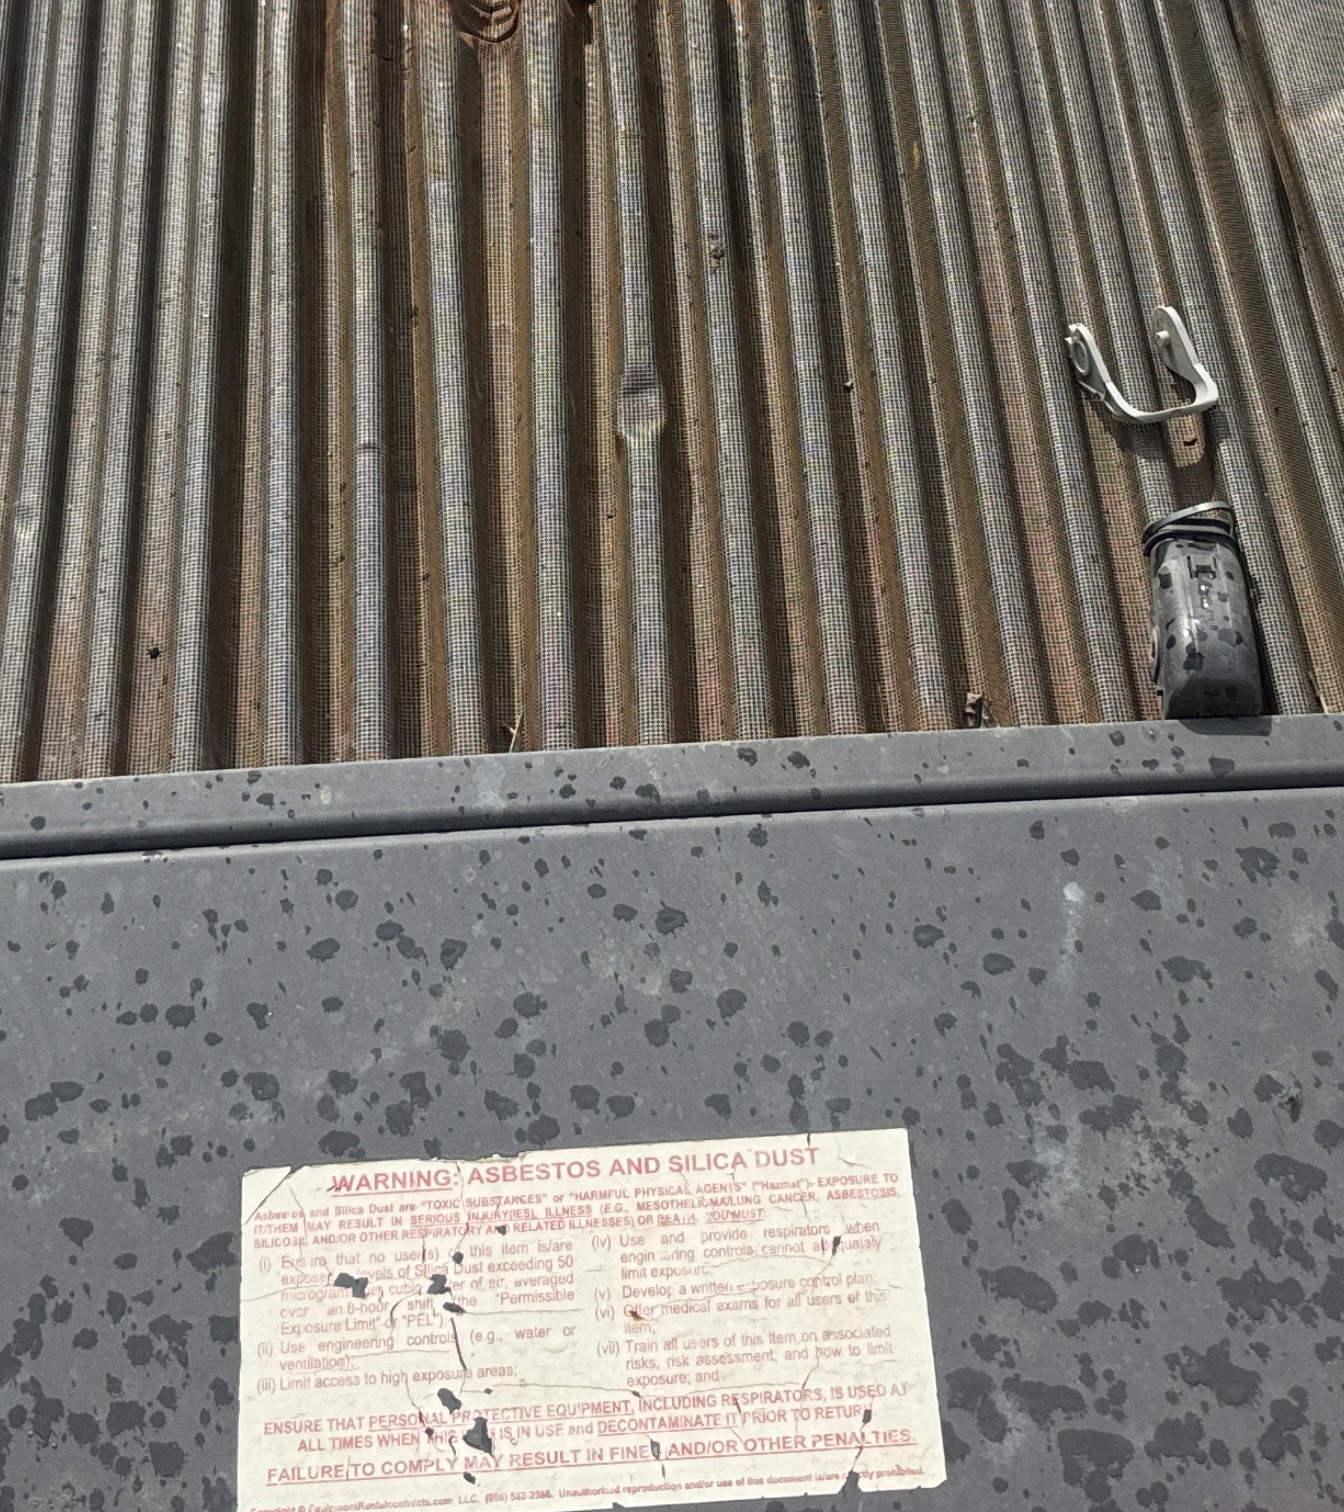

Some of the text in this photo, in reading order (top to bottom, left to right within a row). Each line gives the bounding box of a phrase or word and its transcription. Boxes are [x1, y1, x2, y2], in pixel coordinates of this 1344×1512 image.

[330, 1147, 820, 1193] WARNING: ASBESTOS AND SILICA DUST
[309, 1206, 330, 1218] and
[368, 1203, 395, 1215] Dust
[552, 1193, 564, 1203] or
[634, 1184, 691, 1198] PHYSICAL
[817, 1172, 879, 1188] EXPOSURE
[883, 1171, 899, 1184] TO
[306, 1220, 332, 1233] MAY
[338, 1216, 384, 1230] RESULT
[390, 1214, 403, 1226] IN
[410, 1211, 461, 1225] SERIOUS
[544, 1204, 593, 1218] ILLNESS
[359, 1230, 399, 1243] OTHER
[401, 1226, 482, 1240] RESPIRATORY
[512, 1219, 566, 1233] RELATED
[636, 1215, 654, 1226] OR
[619, 1233, 645, 1248] Use
[660, 1230, 685, 1245] and
[701, 1226, 748, 1246] provide
[763, 1223, 831, 1241] respirators
[335, 1251, 360, 1266] that
[368, 1251, 386, 1264] no
[469, 1240, 492, 1257] this
[501, 1239, 529, 1256] item
[703, 1243, 754, 1259] controls
[397, 1263, 412, 1279] of
[487, 1256, 554, 1275] exceeding
[557, 1254, 574, 1269] 50
[620, 1265, 648, 1281] limit
[470, 1275, 484, 1289] of
[513, 1273, 574, 1290] averaged
[678, 1284, 688, 1296] a
[407, 1297, 435, 1312] shift
[660, 1298, 712, 1316] medical
[715, 1297, 760, 1313] exams
[764, 1295, 782, 1310] for
[786, 1293, 802, 1308] all
[806, 1292, 843, 1307] users
[846, 1290, 861, 1305] of
[864, 1288, 888, 1304] this
[280, 1340, 306, 1355] Use
[317, 1336, 394, 1355] engineering
[406, 1331, 457, 1347] controls
[514, 1325, 552, 1340] water
[562, 1325, 577, 1337] or
[624, 1338, 659, 1355] Train
[662, 1337, 679, 1352] all
[683, 1334, 720, 1351] users
[723, 1333, 737, 1348] of
[741, 1331, 765, 1347] this
[768, 1329, 796, 1346] item
[800, 1329, 818, 1343] on
[625, 1340, 895, 1372] risks, risk assessment, and how to limit
[279, 1376, 311, 1392] Limit
[314, 1374, 361, 1389] access
[364, 1372, 377, 1386] to
[380, 1369, 408, 1387] high
[694, 1368, 721, 1384] and
[263, 1417, 323, 1436] ENSURE
[327, 1415, 366, 1432] THAT
[368, 1411, 448, 1430] PERSONAL
[545, 1398, 635, 1418] EQUIPMENT,
[638, 1393, 717, 1413] INCLUDING
[720, 1386, 827, 1408] RESPIRATORS,
[830, 1385, 844, 1400] IS
[847, 1382, 887, 1399] USED
[297, 1437, 326, 1454] ALL
[330, 1434, 373, 1451] TIMES
[376, 1430, 421, 1448] WHEN
[498, 1425, 513, 1441] IS
[516, 1424, 531, 1440] IN
[535, 1422, 564, 1438] USE
[568, 1419, 594, 1436] and
[597, 1411, 722, 1434] DECONTAMINATE
[725, 1412, 738, 1426] IT
[791, 1406, 811, 1422] TO
[266, 1428, 916, 1484] FAILURE TO COMPLY MAY RESULT IN AND/OR OTHER PENALTIES.
